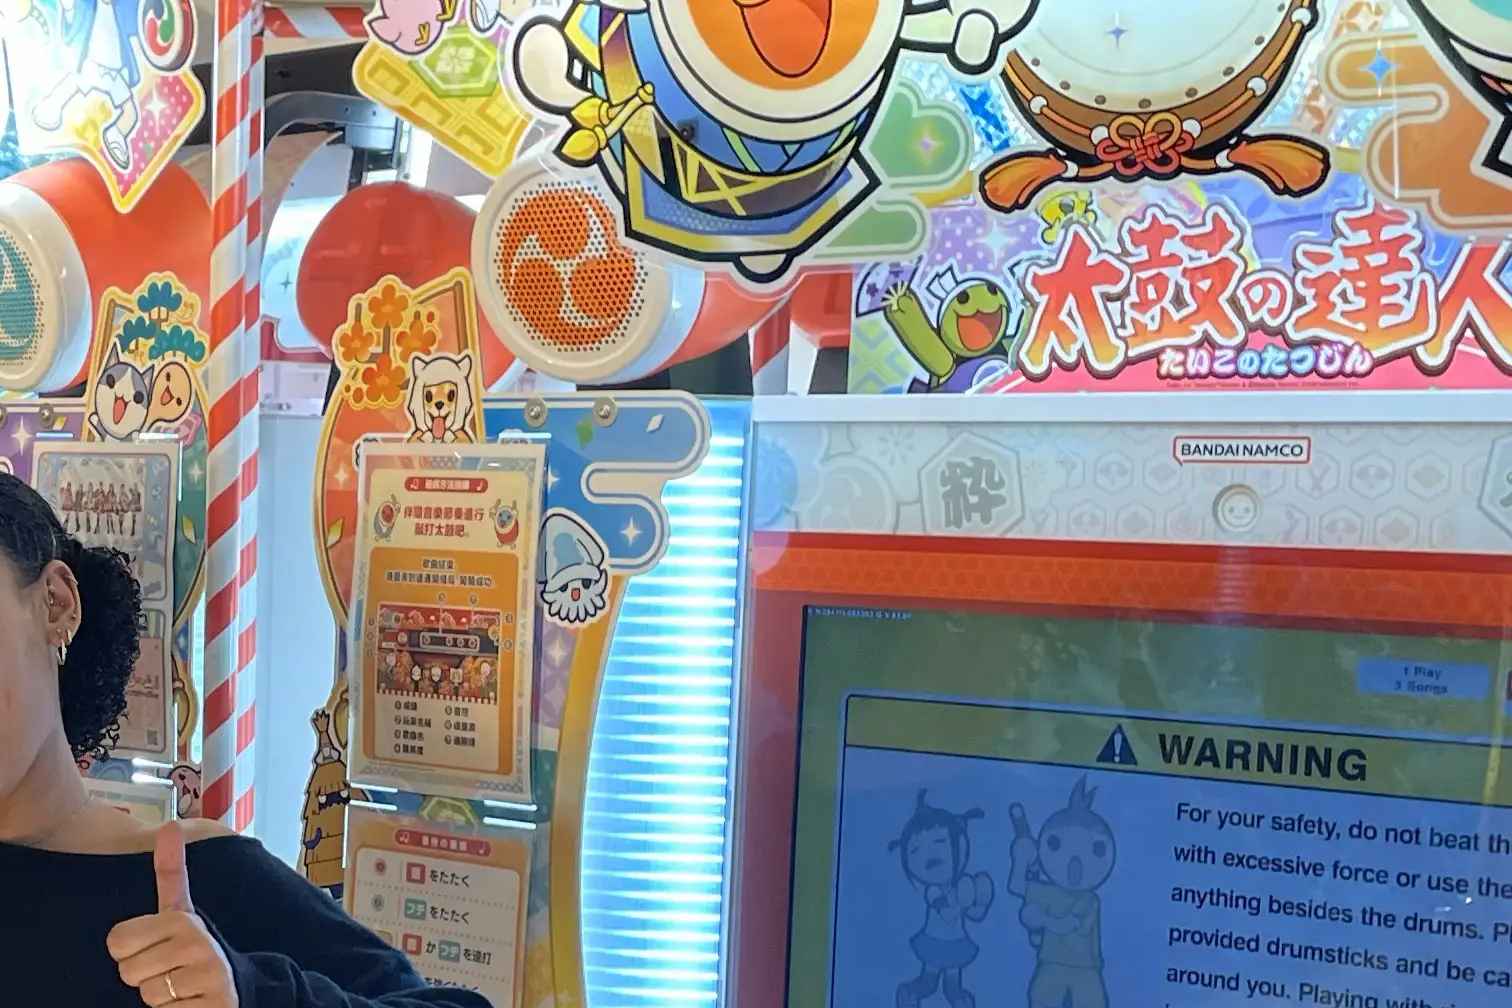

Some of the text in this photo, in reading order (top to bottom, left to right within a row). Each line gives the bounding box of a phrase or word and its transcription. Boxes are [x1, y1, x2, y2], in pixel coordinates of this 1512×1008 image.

[1018, 203, 1512, 375] 太鼓の達人
[1157, 347, 1373, 377] たいこのたつじん
[1180, 443, 1303, 459] BANDAI NAMCO
[1158, 733, 1369, 782] WARNING
[1176, 802, 1212, 823] For
[1218, 810, 1265, 830] your
[1271, 814, 1341, 840] safety,
[1348, 820, 1377, 841] do
[1385, 827, 1421, 846] not
[1429, 828, 1480, 852] beat
[429, 869, 470, 888] をたたく
[1174, 845, 1216, 866] with
[1223, 853, 1325, 877] excessive
[1332, 861, 1389, 885] force
[1396, 871, 1421, 888] or
[1428, 874, 1469, 895] use
[406, 902, 470, 925] フチ をたたく
[1171, 884, 1261, 916] anything
[1269, 895, 1353, 924] besides
[1362, 906, 1396, 929] the
[1403, 913, 1484, 940] drums.
[1168, 925, 1512, 988] provided drumsticks and be ca
[1167, 964, 1240, 991] around
[1247, 978, 1290, 1000] you.
